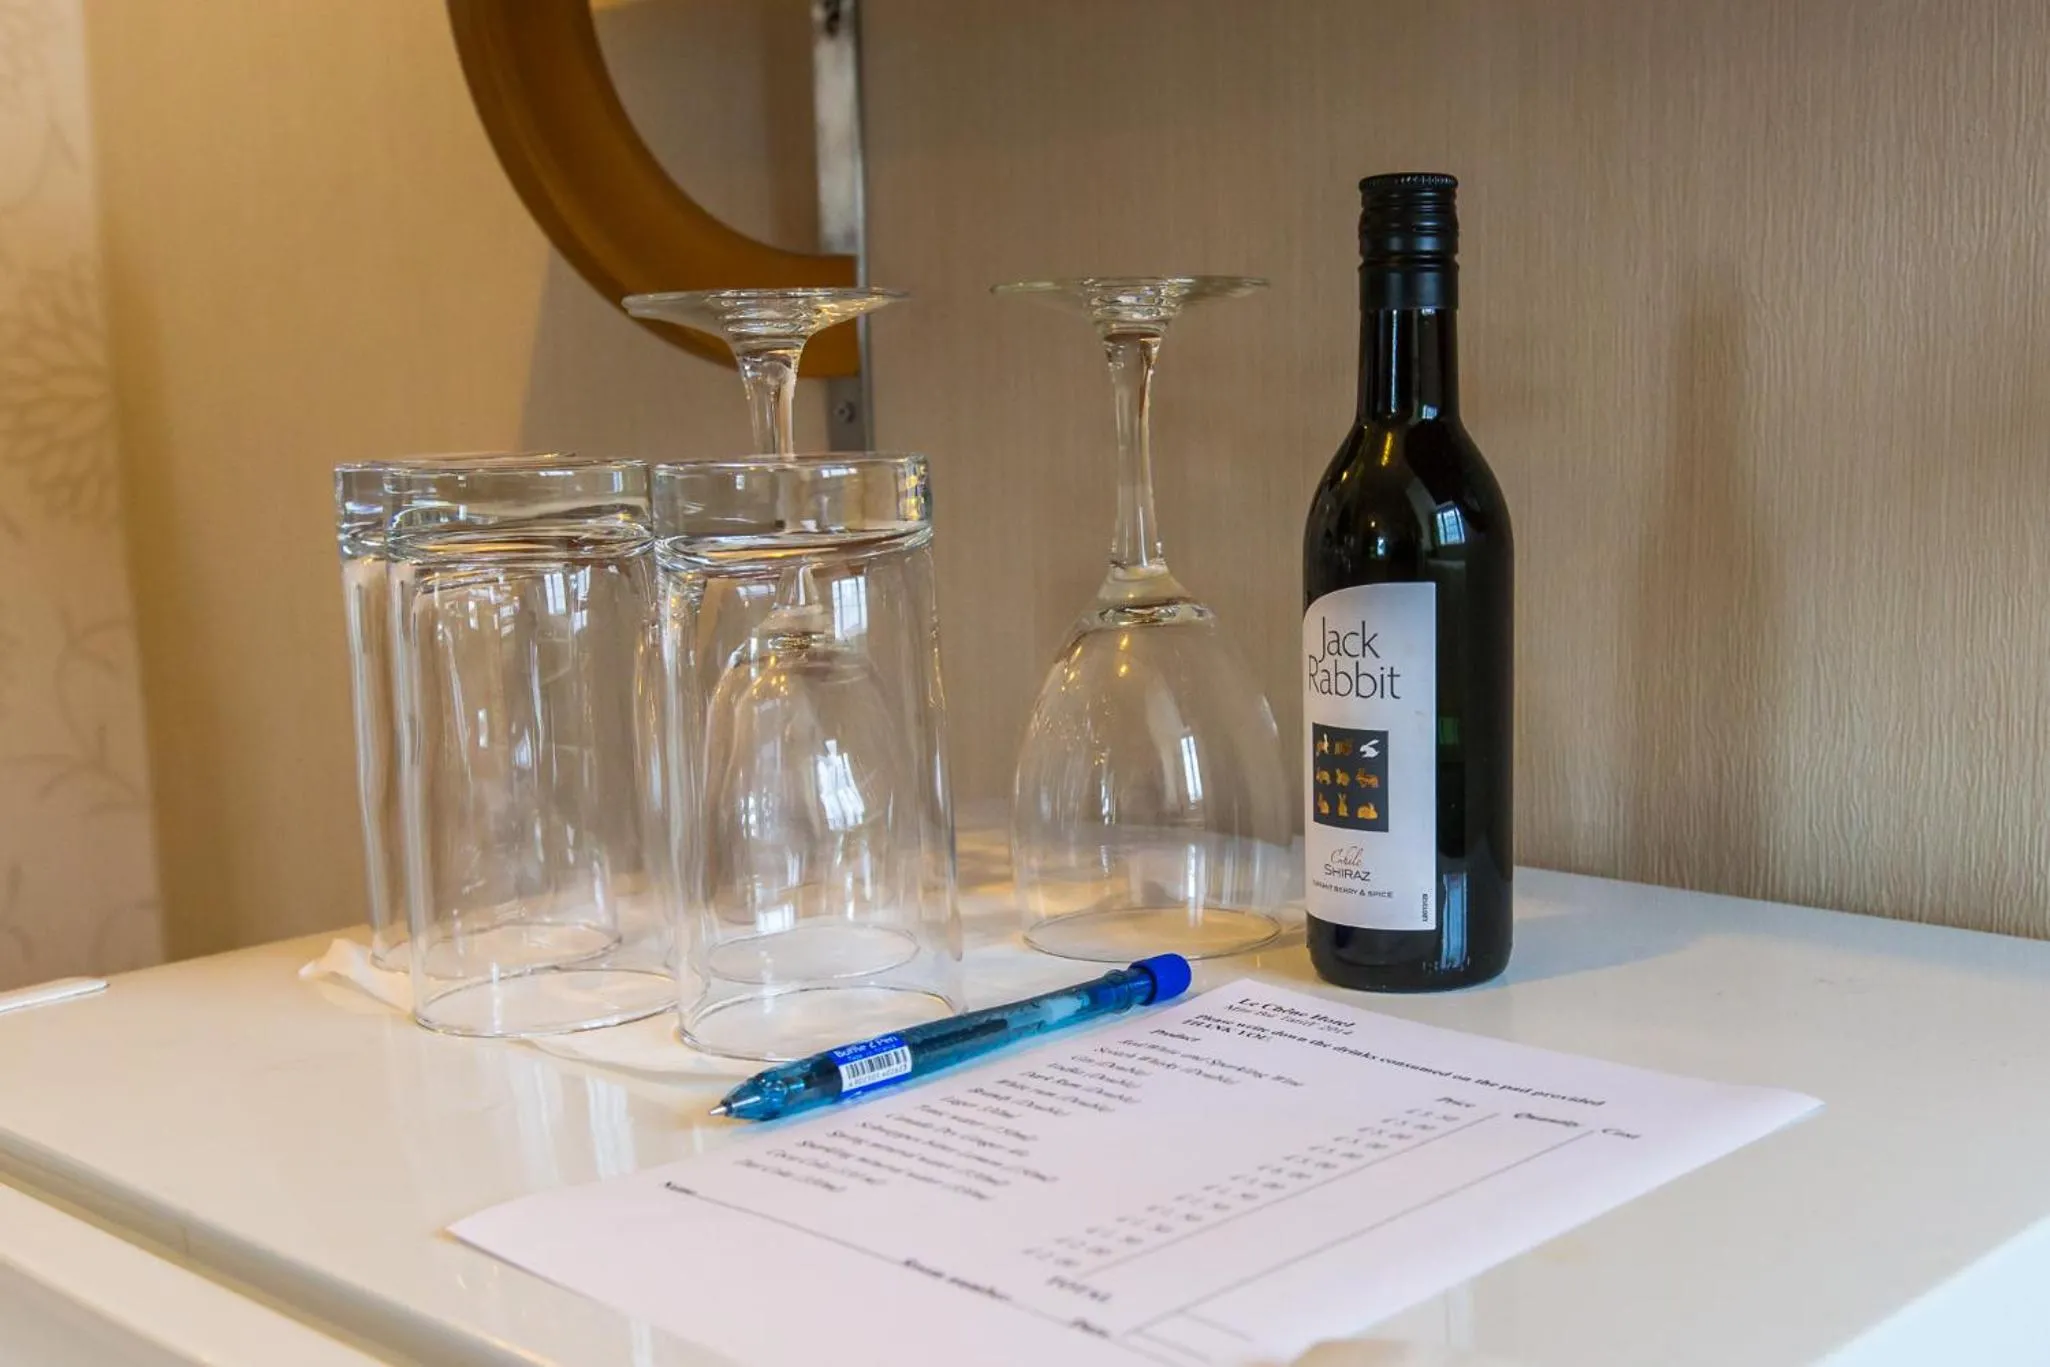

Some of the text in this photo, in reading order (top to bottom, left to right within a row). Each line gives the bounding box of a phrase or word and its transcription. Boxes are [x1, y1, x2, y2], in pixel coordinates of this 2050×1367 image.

[1319, 616, 1380, 663] Jack
[1308, 655, 1401, 699] Rabbit
[1323, 864, 1371, 881] SHIRAZ
[1367, 891, 1394, 899] SPICE
[1182, 1018, 1231, 1034] THANK
[1238, 998, 1260, 1007] Le
[1310, 1013, 1356, 1028] Hotel
[1195, 1014, 1606, 1107] Please write down the drinks consumed on the pad provided
